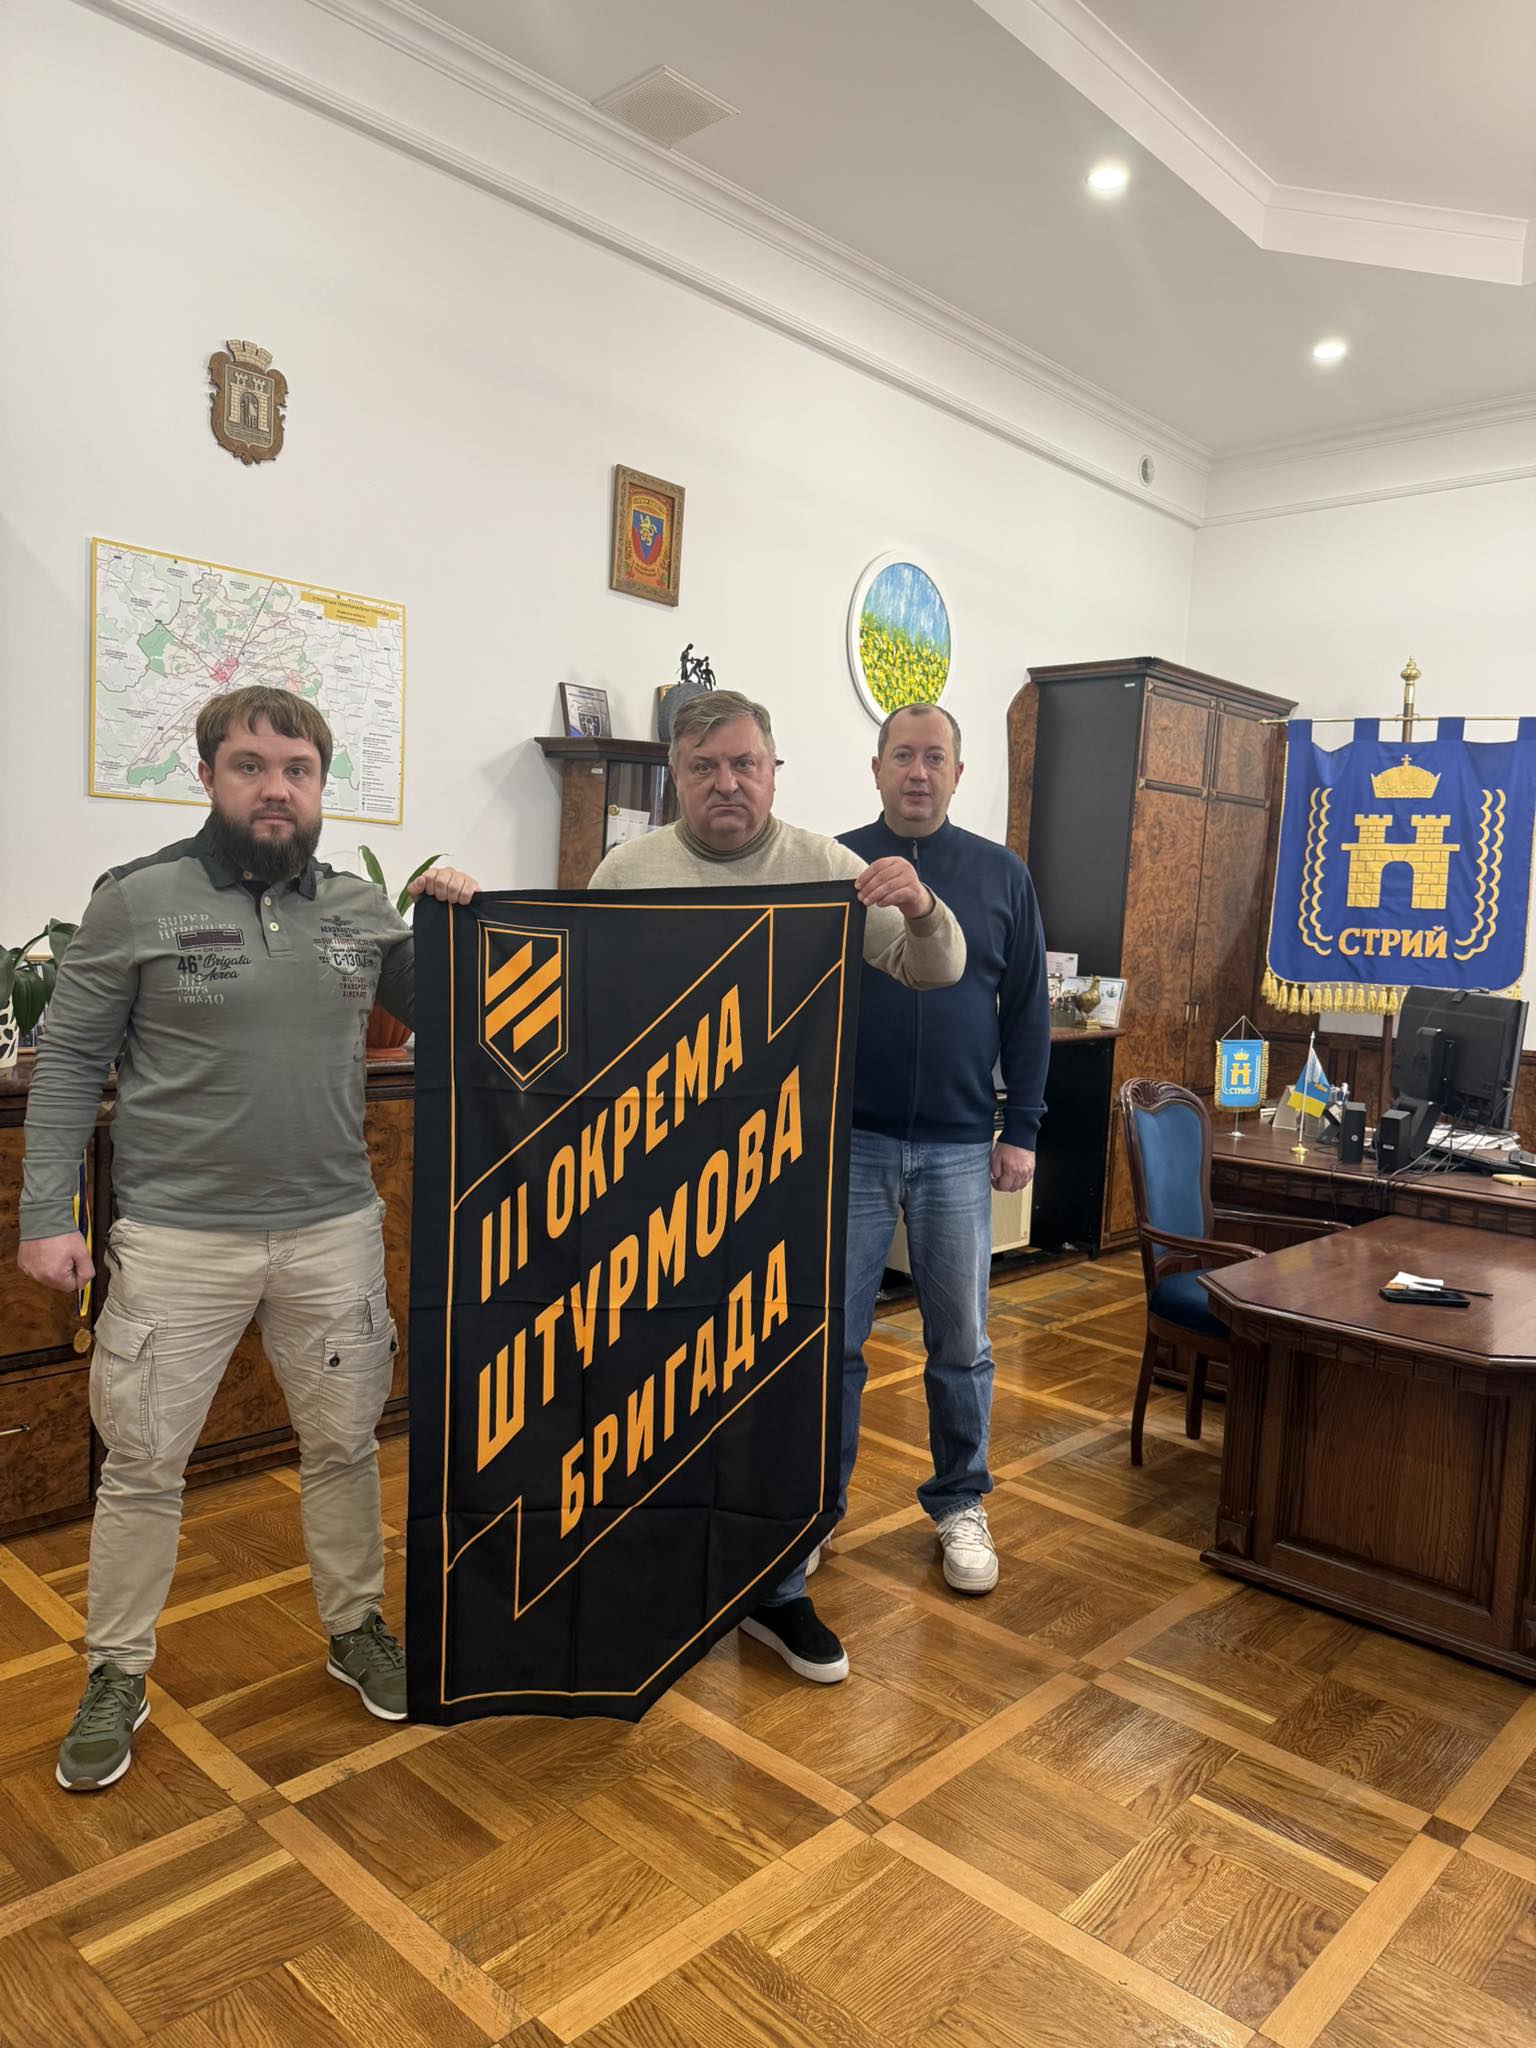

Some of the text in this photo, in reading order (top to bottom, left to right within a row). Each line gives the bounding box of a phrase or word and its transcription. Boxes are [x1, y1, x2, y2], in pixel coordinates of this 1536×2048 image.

[194, 966, 240, 983] Aerea
[203, 953, 252, 970] Brigata
[1338, 925, 1448, 959] СТРИЙ
[546, 984, 744, 1240] ОКРЕМА
[476, 1065, 803, 1474] ШТУРМОВА
[560, 1239, 790, 1538] БРИГАДА
